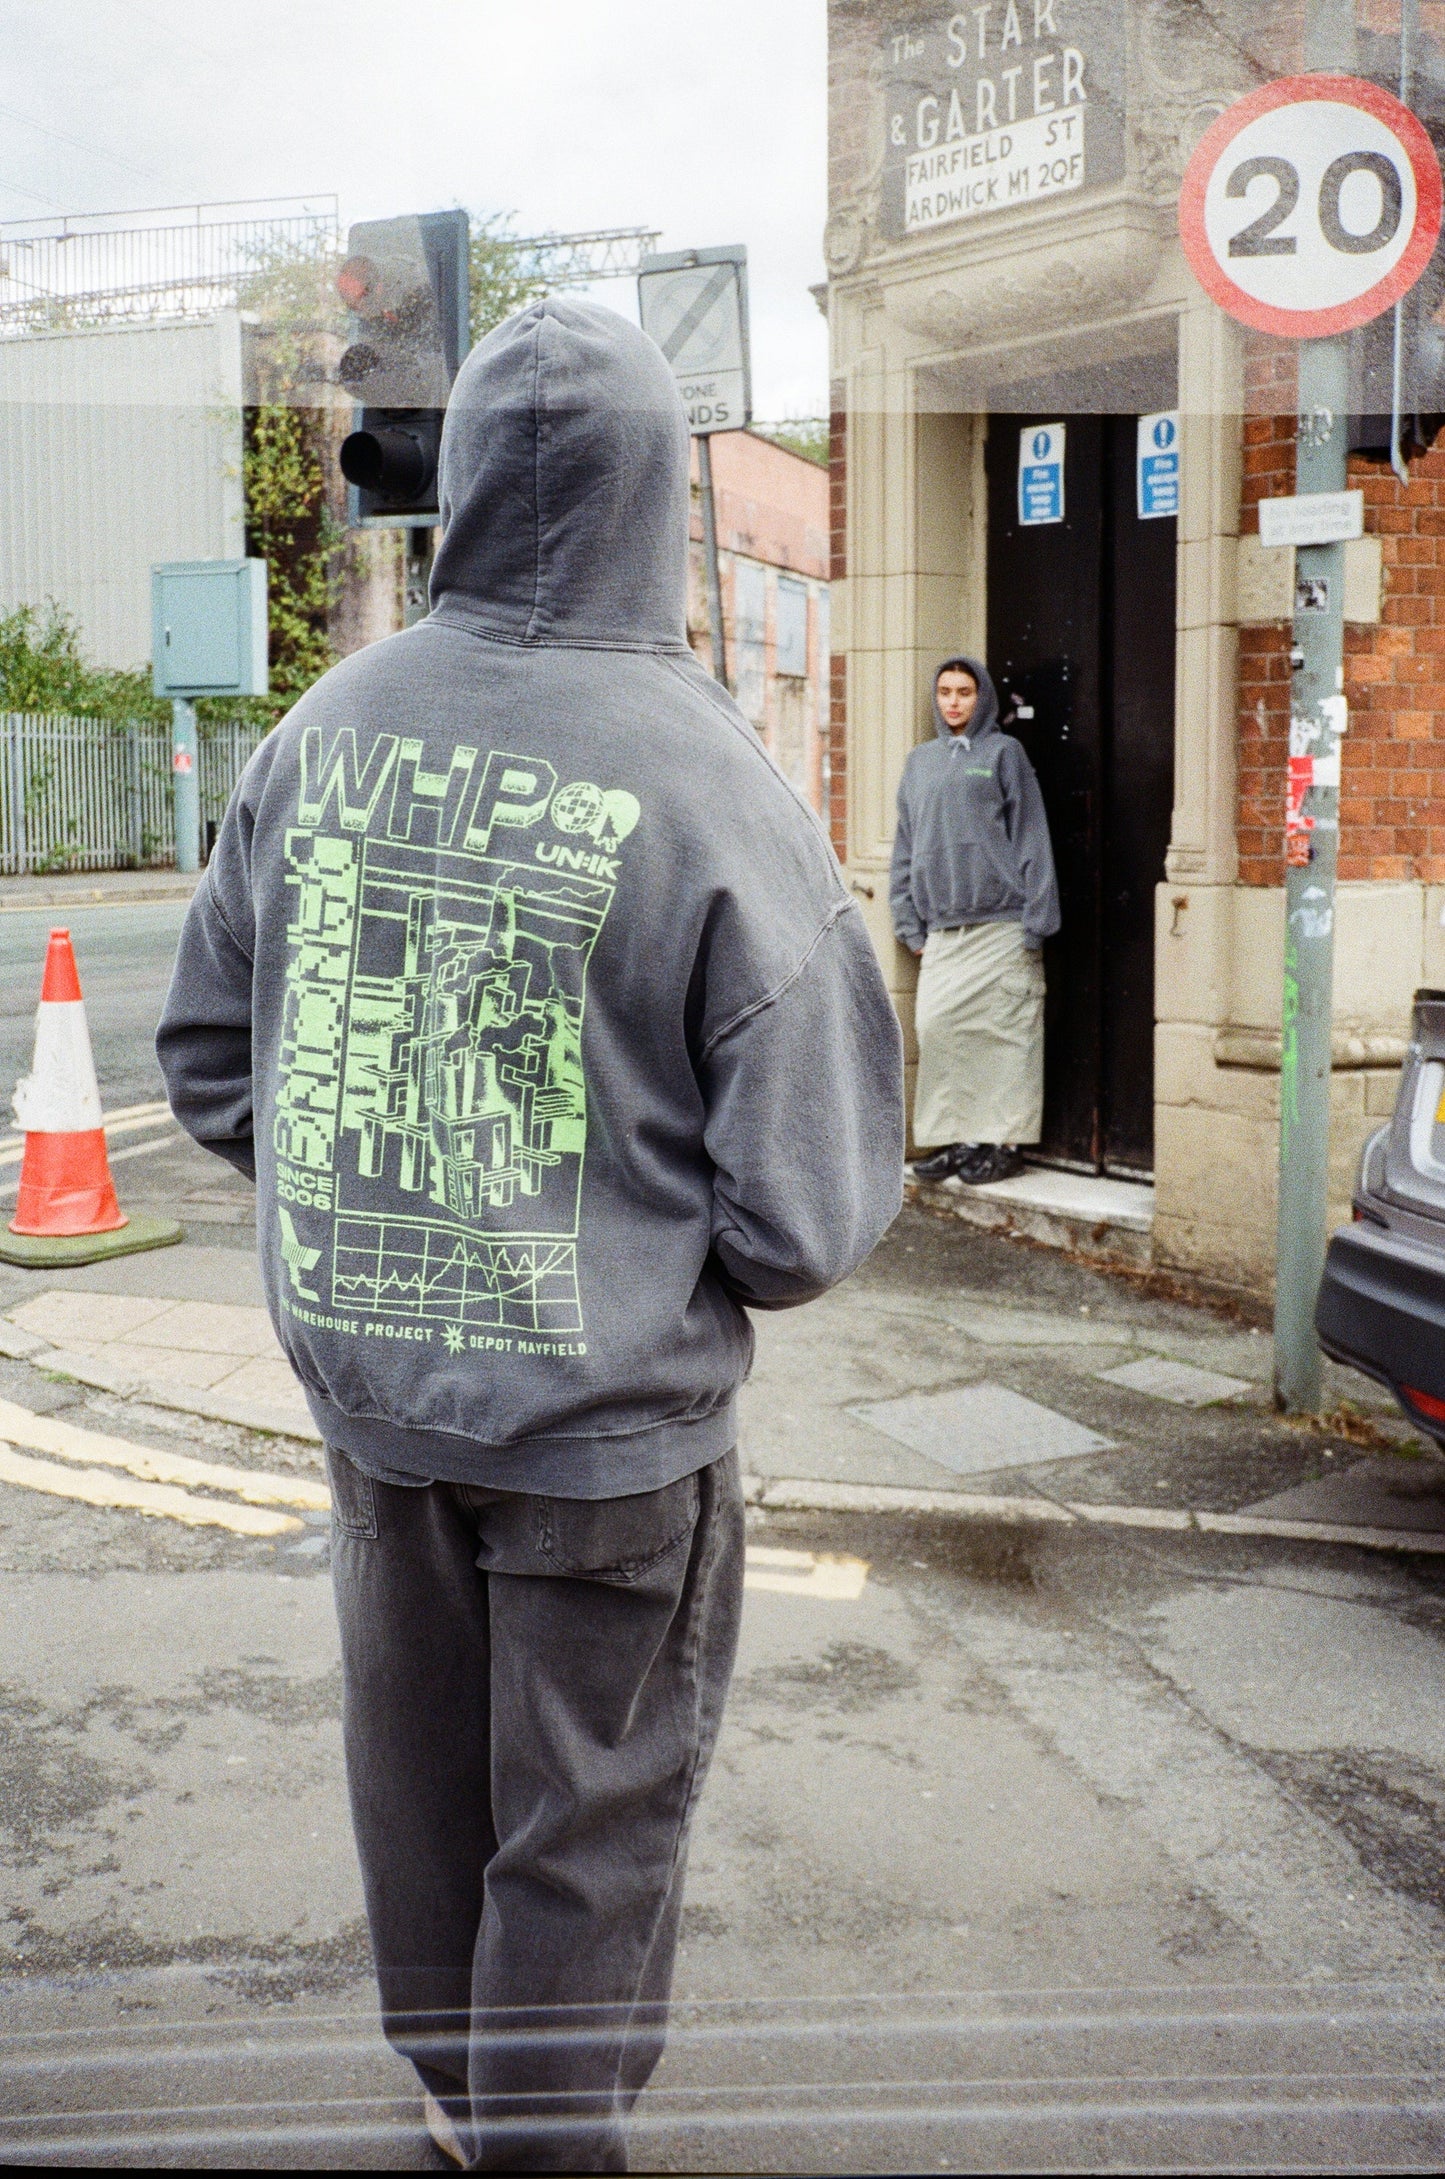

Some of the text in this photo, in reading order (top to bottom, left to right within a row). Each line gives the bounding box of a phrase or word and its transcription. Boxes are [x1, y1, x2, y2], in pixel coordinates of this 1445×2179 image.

[891, 0, 1057, 68] The STAR
[891, 47, 1087, 149] & GARTER
[908, 115, 1077, 186] FAIRFIELD ST
[908, 177, 999, 224] ARDWICK
[1008, 166, 1030, 196] M1
[1225, 150, 1403, 258] 20
[681, 383, 717, 400] ONE
[298, 726, 558, 853] WHP
[276, 1161, 334, 1194] SINCE
[277, 1179, 332, 1211] 2006
[291, 1303, 588, 1357] WAREHOUSE PROJECT DEPOT MAYFIELD
